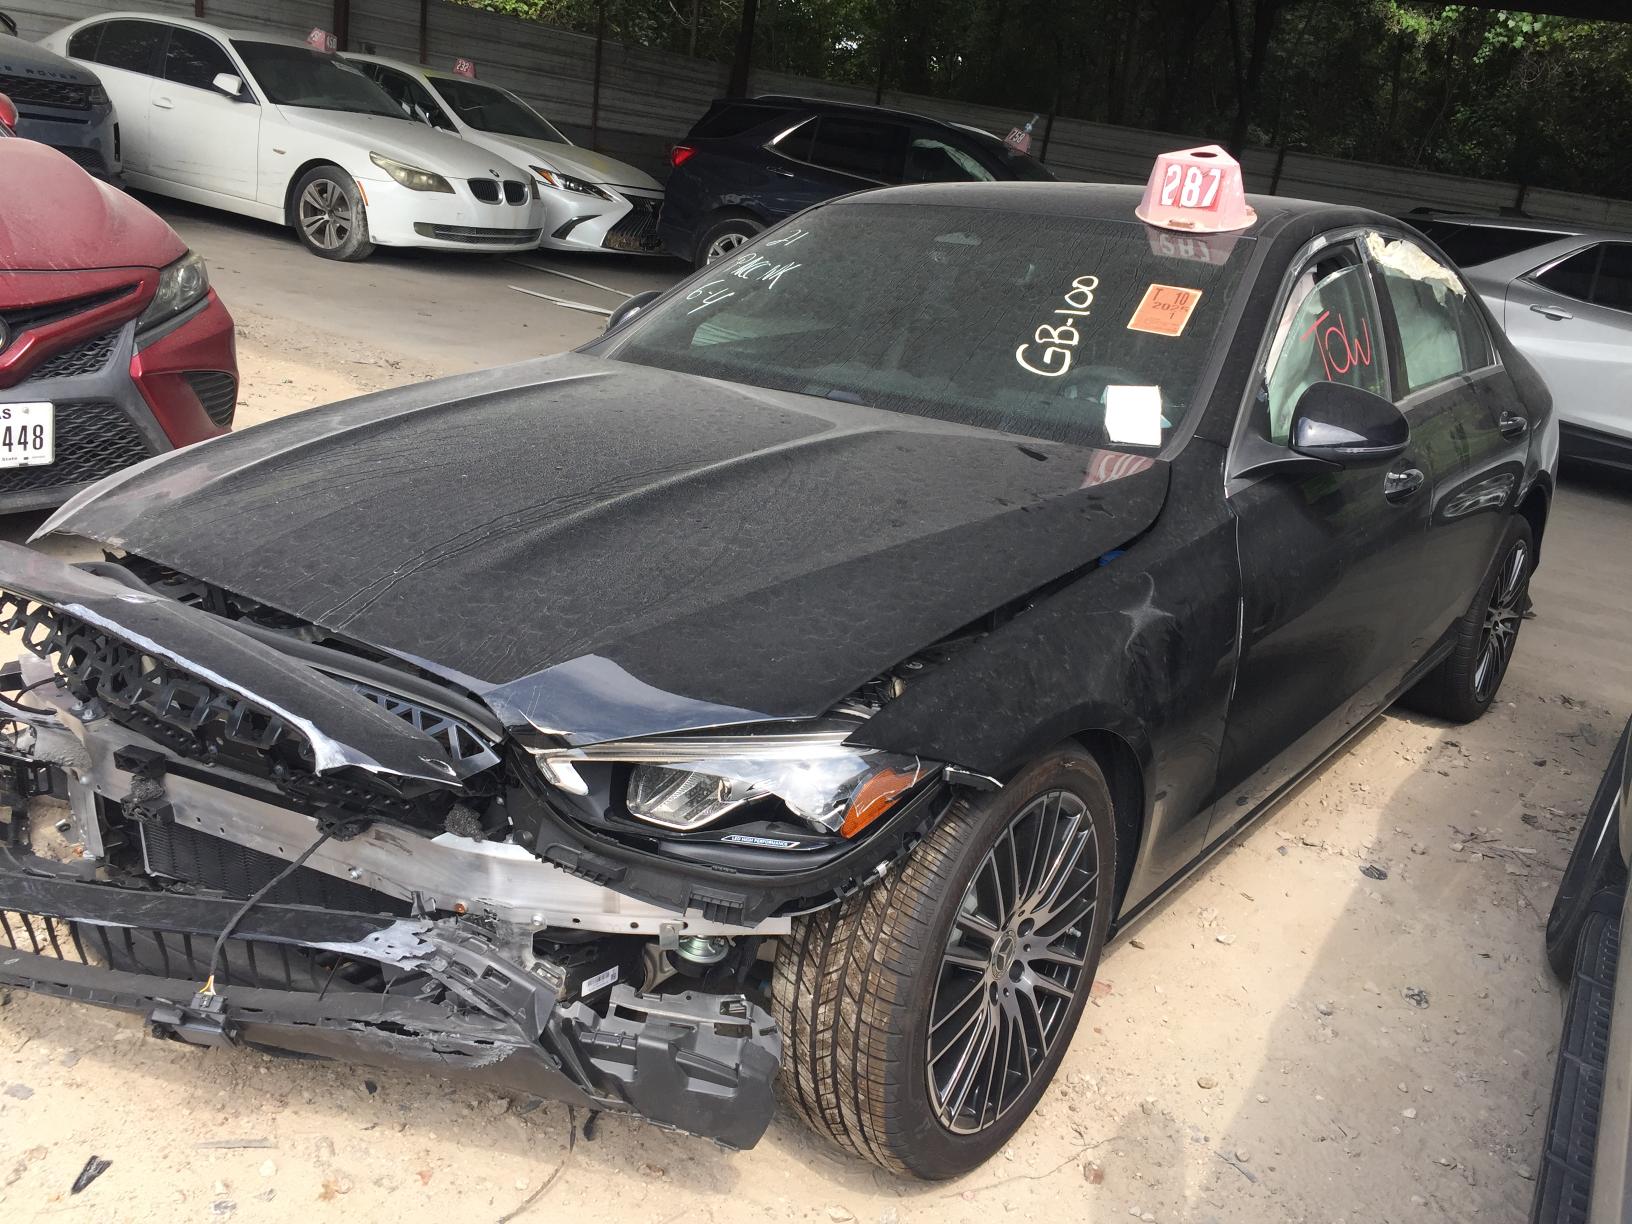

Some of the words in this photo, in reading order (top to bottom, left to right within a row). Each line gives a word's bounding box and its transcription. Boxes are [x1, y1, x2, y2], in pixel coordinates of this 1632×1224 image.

[25, 68, 78, 80] ROVER
[1160, 163, 1222, 209] 287
[1152, 288, 1163, 301] T
[1174, 292, 1190, 306] 10
[1015, 275, 1099, 377] GB-100
